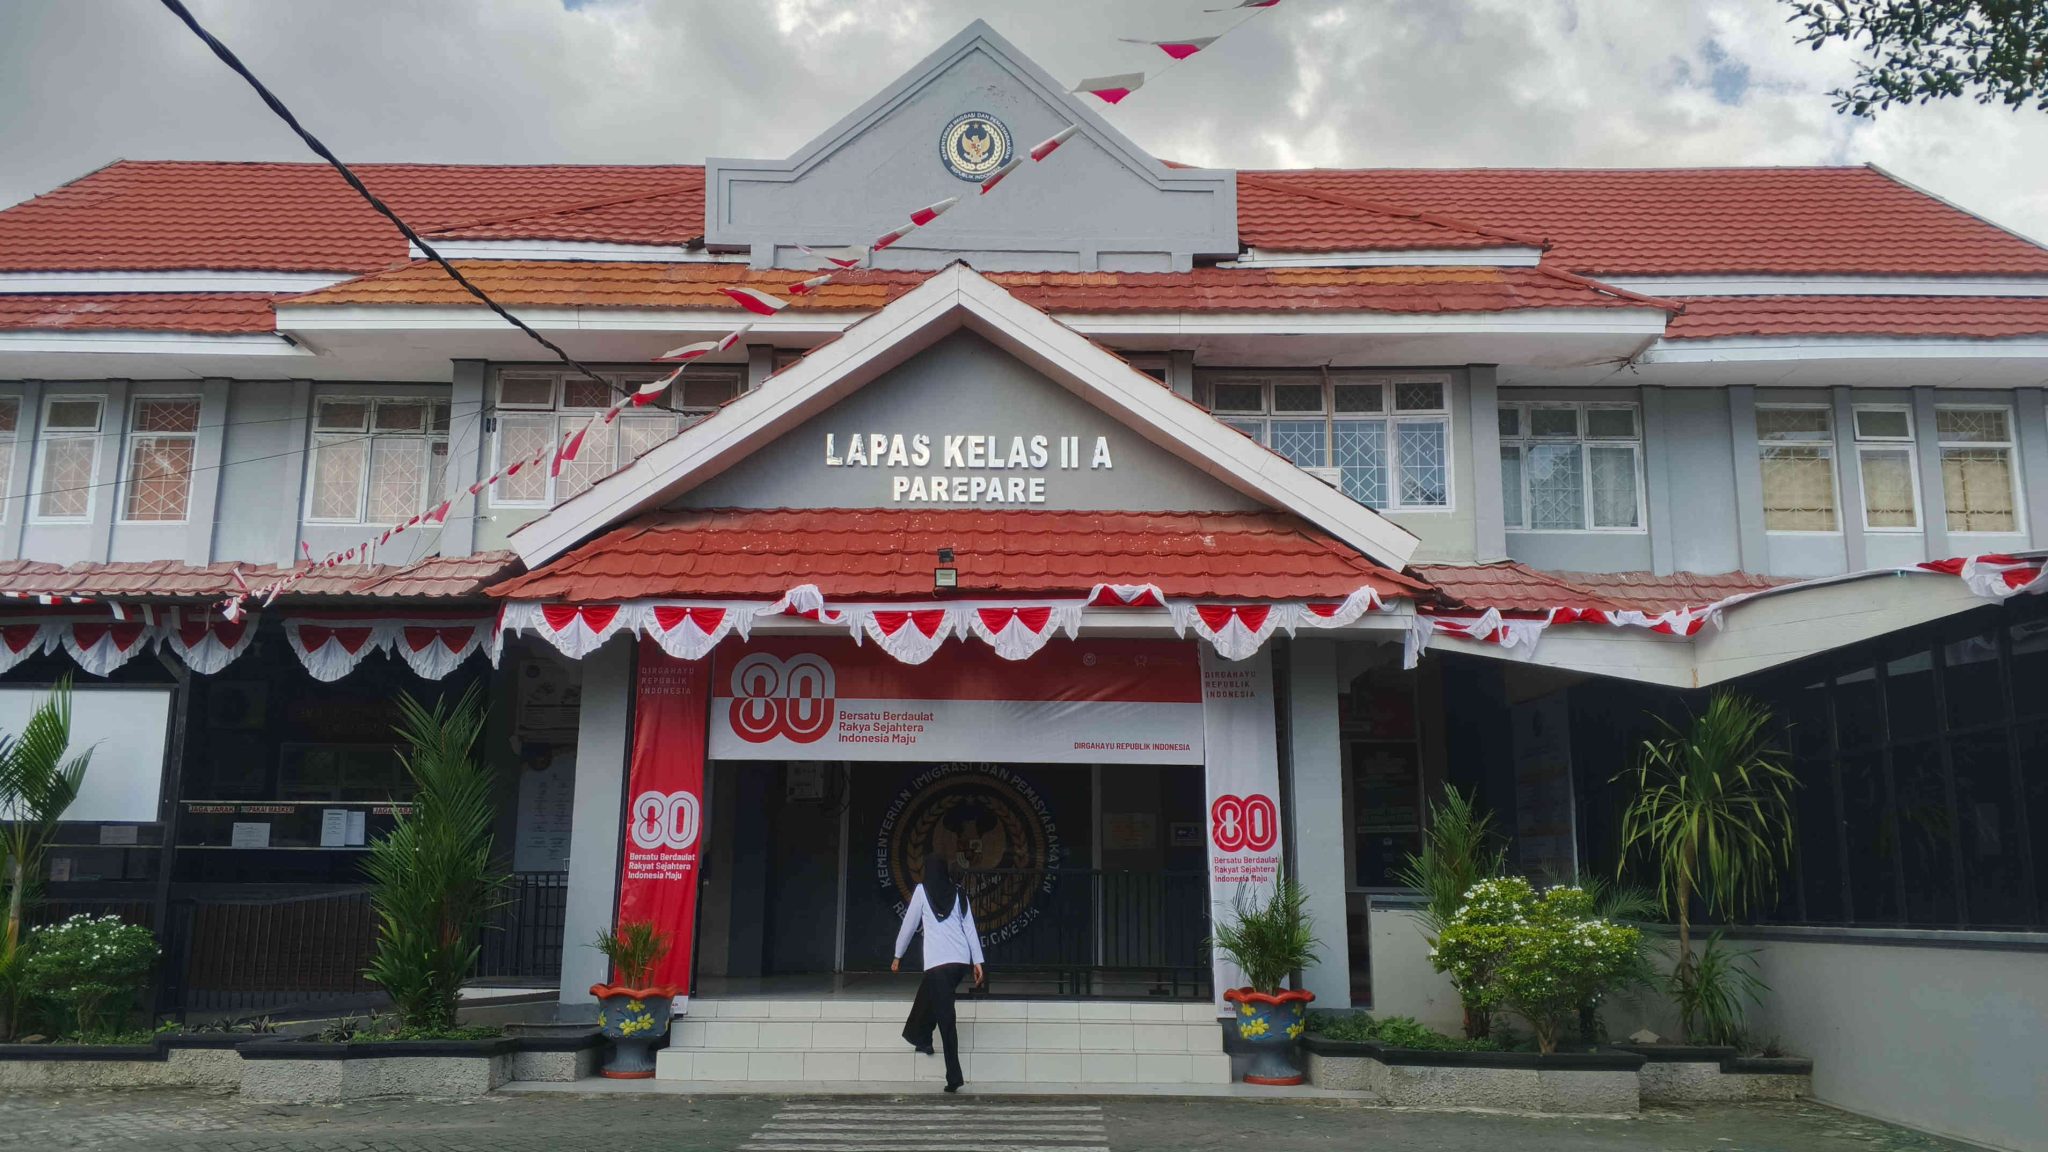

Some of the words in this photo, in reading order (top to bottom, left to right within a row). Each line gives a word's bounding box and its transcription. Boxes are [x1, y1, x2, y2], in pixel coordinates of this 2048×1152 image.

[826, 433, 930, 467] LAPAS
[944, 435, 1048, 469] KELAS
[1060, 436, 1079, 469] II
[1091, 436, 1112, 469] A
[893, 476, 1046, 503] PAREPARE
[729, 652, 836, 744] 80
[839, 711, 881, 721] Bersatu
[883, 711, 934, 722] Berdaulat
[839, 722, 870, 733] Rakya
[873, 722, 924, 734] Sejahtera
[838, 733, 889, 744] Indonesia
[892, 734, 916, 746] Maju
[1074, 742, 1115, 750] DIRGAHAYU
[1116, 742, 1150, 750] REPUBLIK
[1152, 743, 1191, 751] INDONESIA
[631, 790, 700, 850] 80
[877, 789, 912, 888] KEMENTERIAN
[912, 762, 973, 790] IMIGRASI
[979, 762, 1009, 779] DAN
[1211, 794, 1278, 853] 80
[660, 853, 695, 861] Berdaulat
[1214, 856, 1242, 864] Bersatu
[1243, 856, 1278, 864] Berdaulat
[628, 861, 654, 871] Rakyat
[656, 862, 691, 871] Sejahtera
[1214, 866, 1239, 874] Rakyat
[1240, 866, 1275, 874] Sejahtera
[628, 871, 664, 879] Indonesia
[665, 872, 682, 881] Maju
[1251, 875, 1268, 883] Maju
[979, 908, 1040, 947] DONESIA
